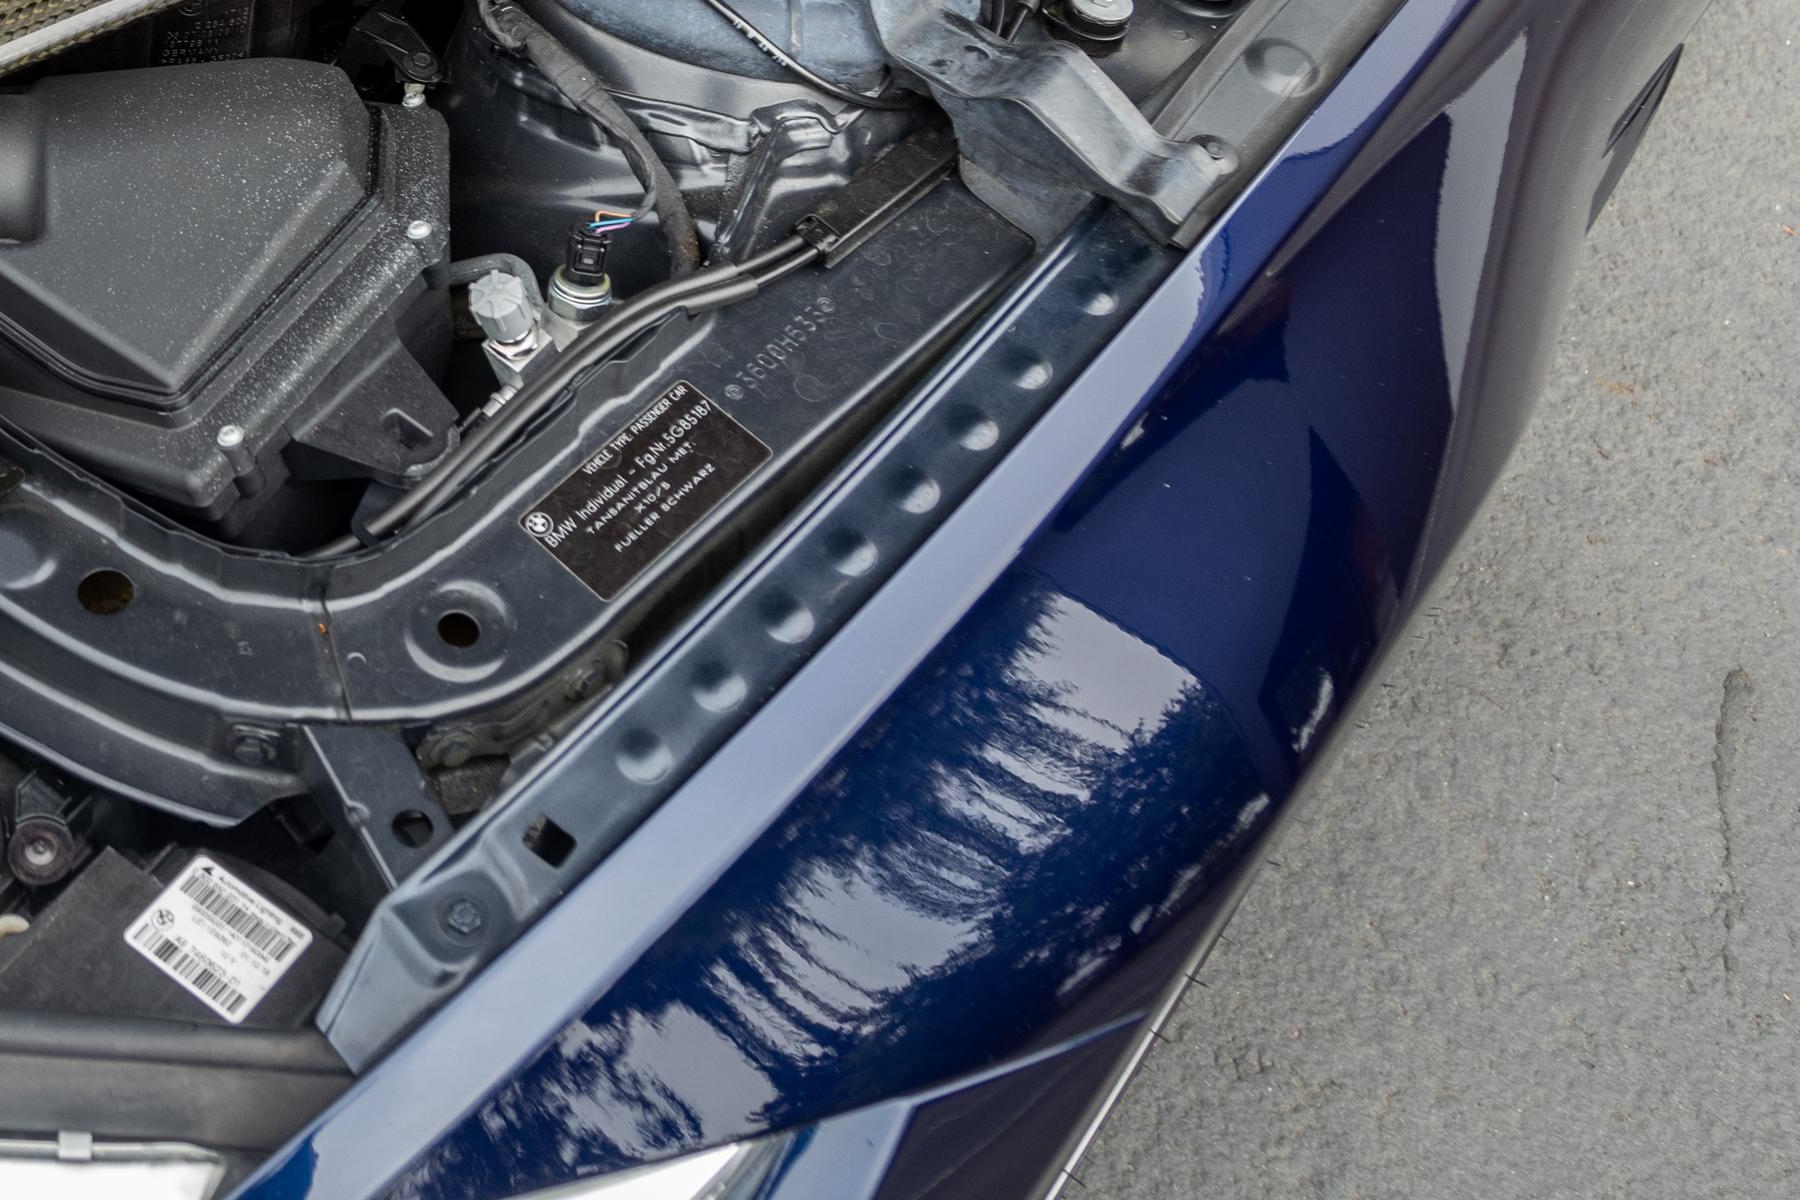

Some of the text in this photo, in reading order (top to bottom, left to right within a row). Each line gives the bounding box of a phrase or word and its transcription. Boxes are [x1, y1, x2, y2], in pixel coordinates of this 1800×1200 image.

[581, 450, 613, 476] VEHICLE
[630, 398, 673, 435] PASSENGER
[671, 384, 688, 401] CAR
[545, 517, 578, 548] BMW
[575, 474, 629, 521] Individual
[614, 462, 716, 553] FUELLER SCHWARZ
